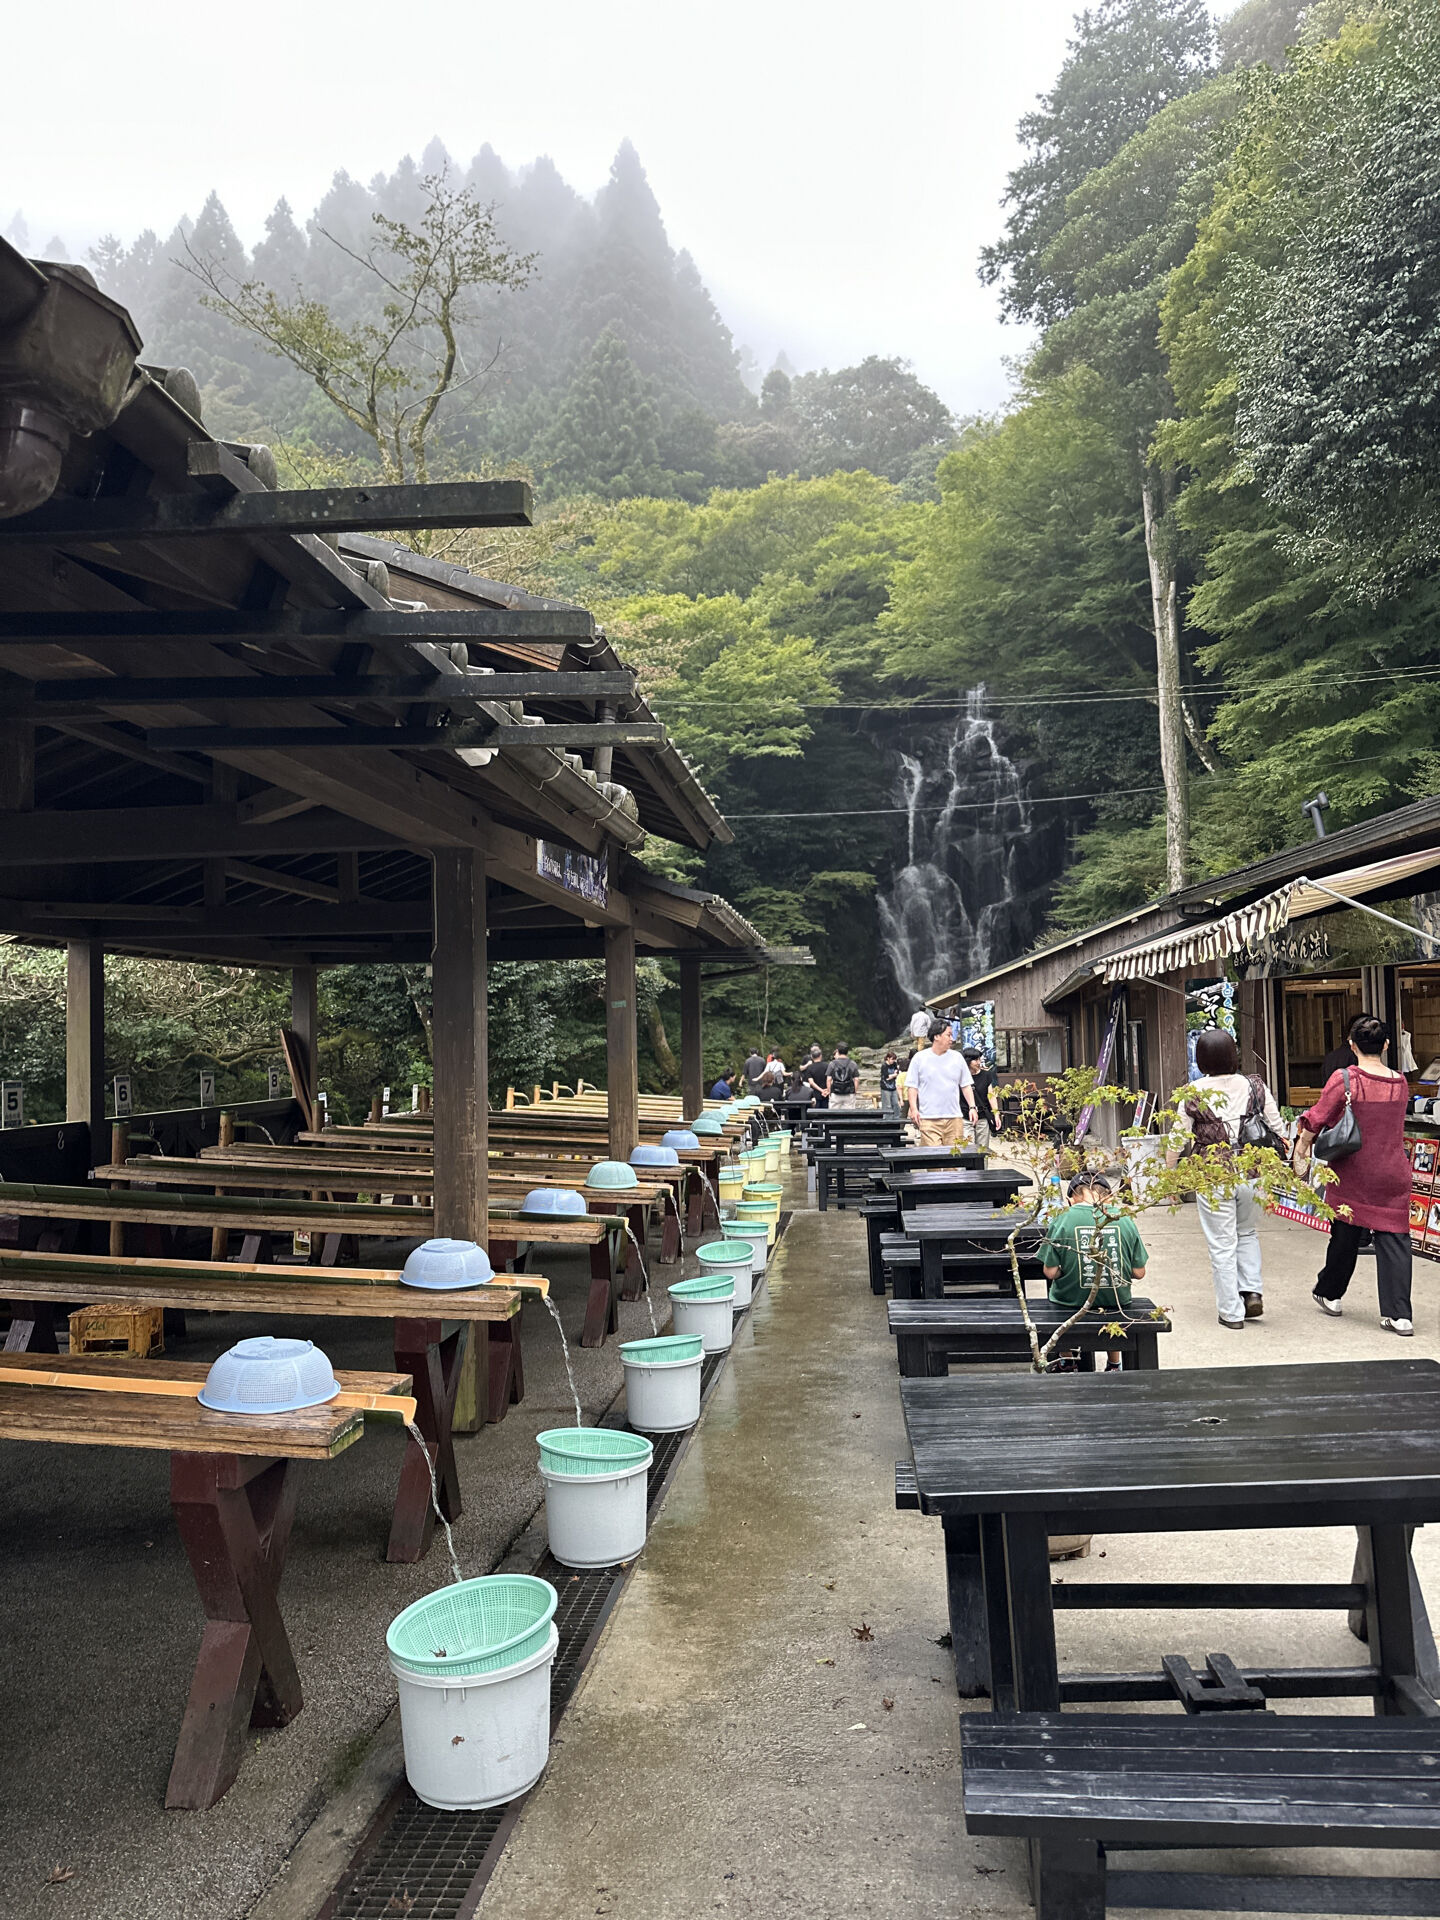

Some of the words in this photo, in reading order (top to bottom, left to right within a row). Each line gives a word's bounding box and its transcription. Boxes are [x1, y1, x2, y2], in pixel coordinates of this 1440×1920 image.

[1270, 929, 1331, 962] そうめん流し
[203, 1078, 212, 1094] 7
[271, 1074, 278, 1088] 8
[7, 1091, 19, 1111] 5
[118, 1084, 128, 1102] 6
